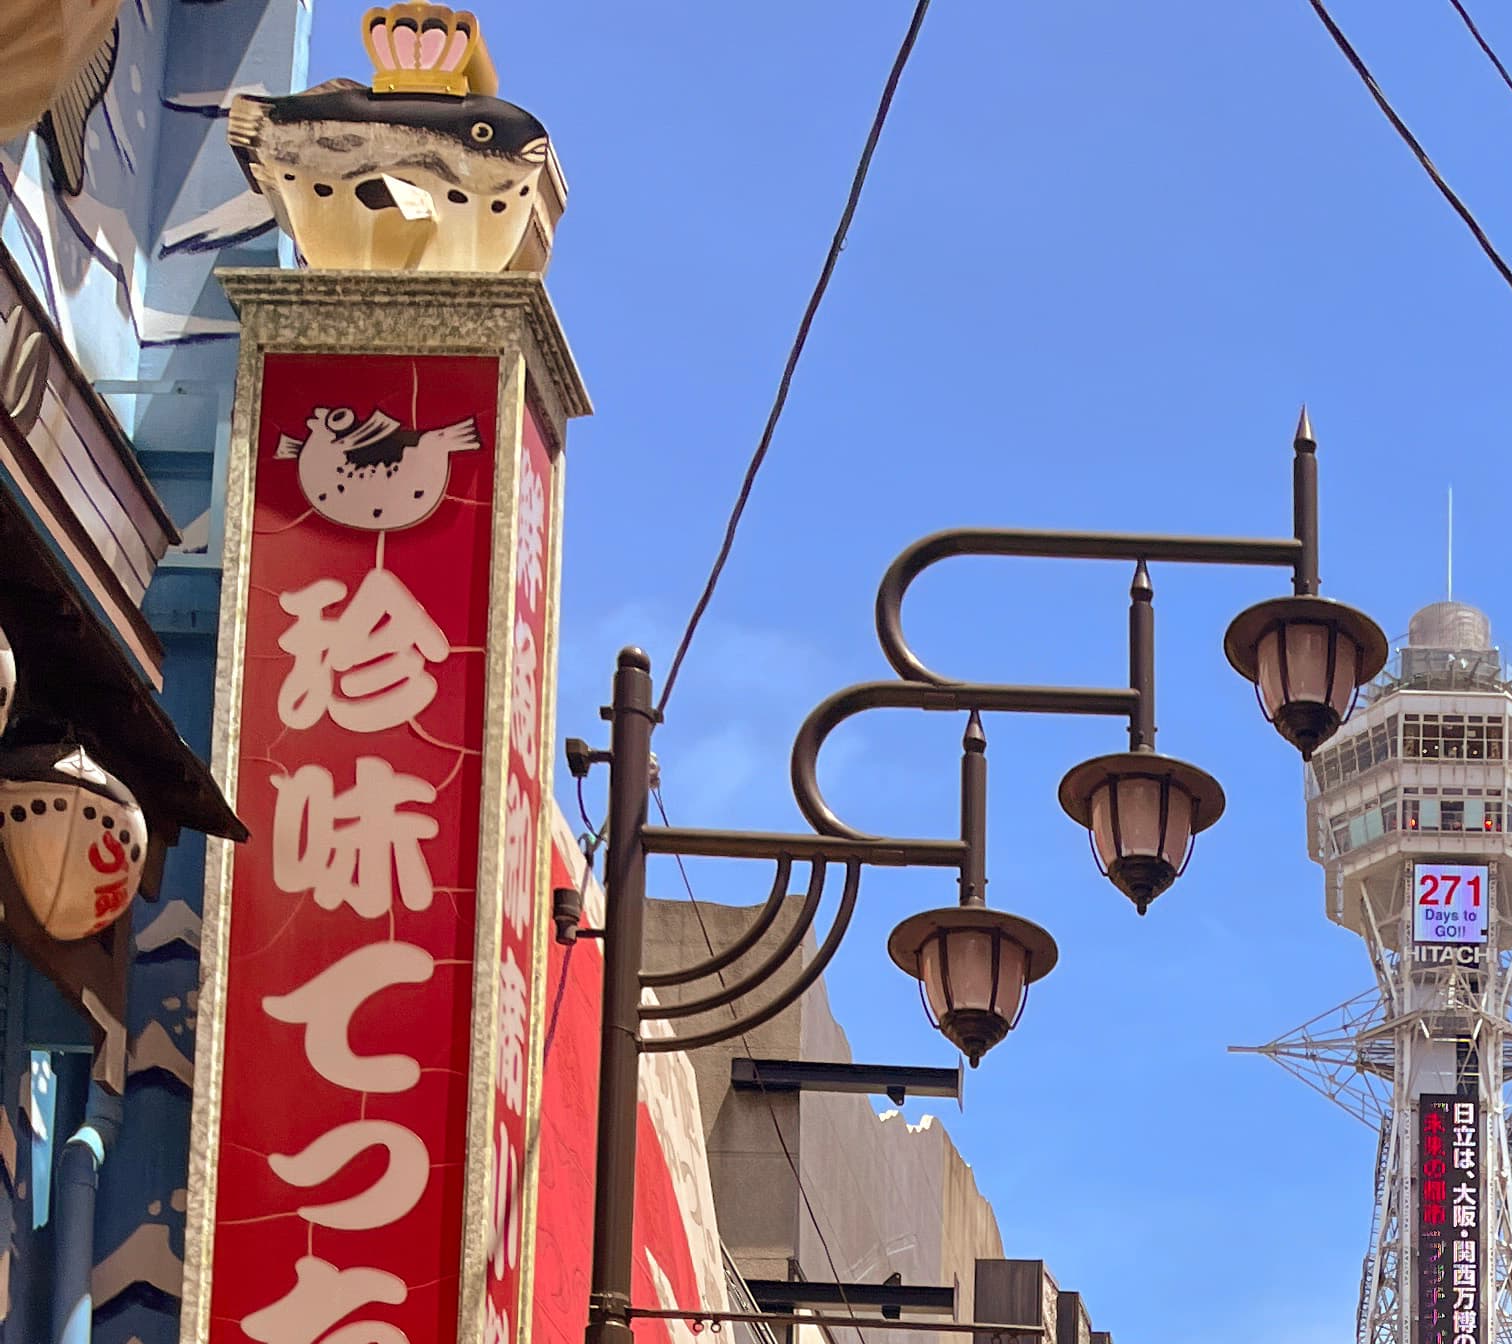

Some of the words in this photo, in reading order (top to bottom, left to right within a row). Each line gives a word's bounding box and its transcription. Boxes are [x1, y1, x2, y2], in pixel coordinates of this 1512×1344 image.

[1418, 874, 1481, 906] 271
[1425, 908, 1459, 923] Days
[1463, 909, 1477, 922] to
[1435, 925, 1466, 937] GO!!
